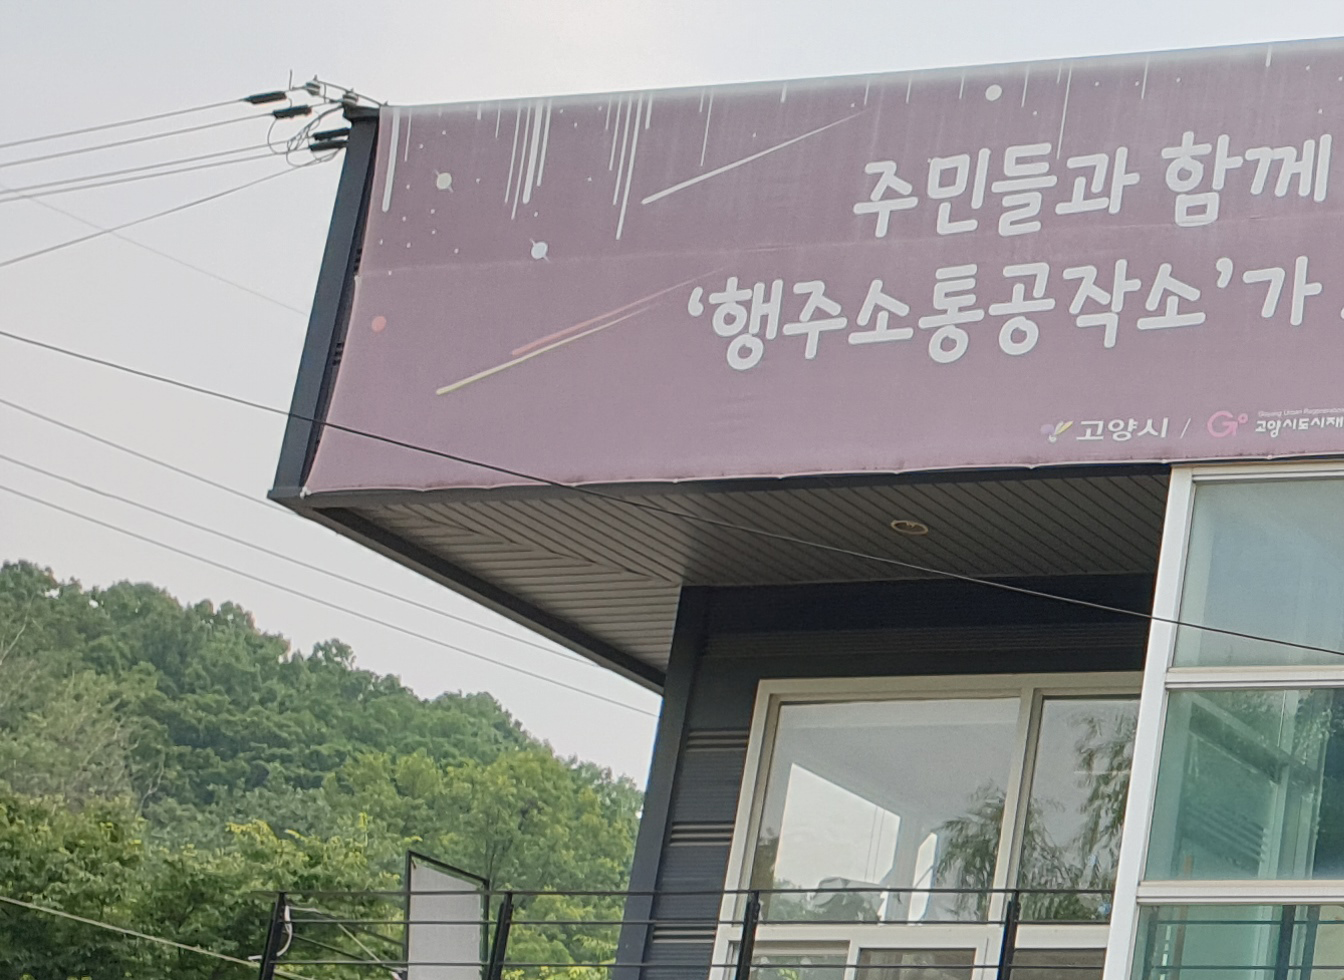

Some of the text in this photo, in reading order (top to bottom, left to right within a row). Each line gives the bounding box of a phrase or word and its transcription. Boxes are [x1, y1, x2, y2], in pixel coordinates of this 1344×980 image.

[853, 141, 1141, 238] 주민들과
[1160, 131, 1333, 228] 함께
[1075, 417, 1169, 441] 고양시
